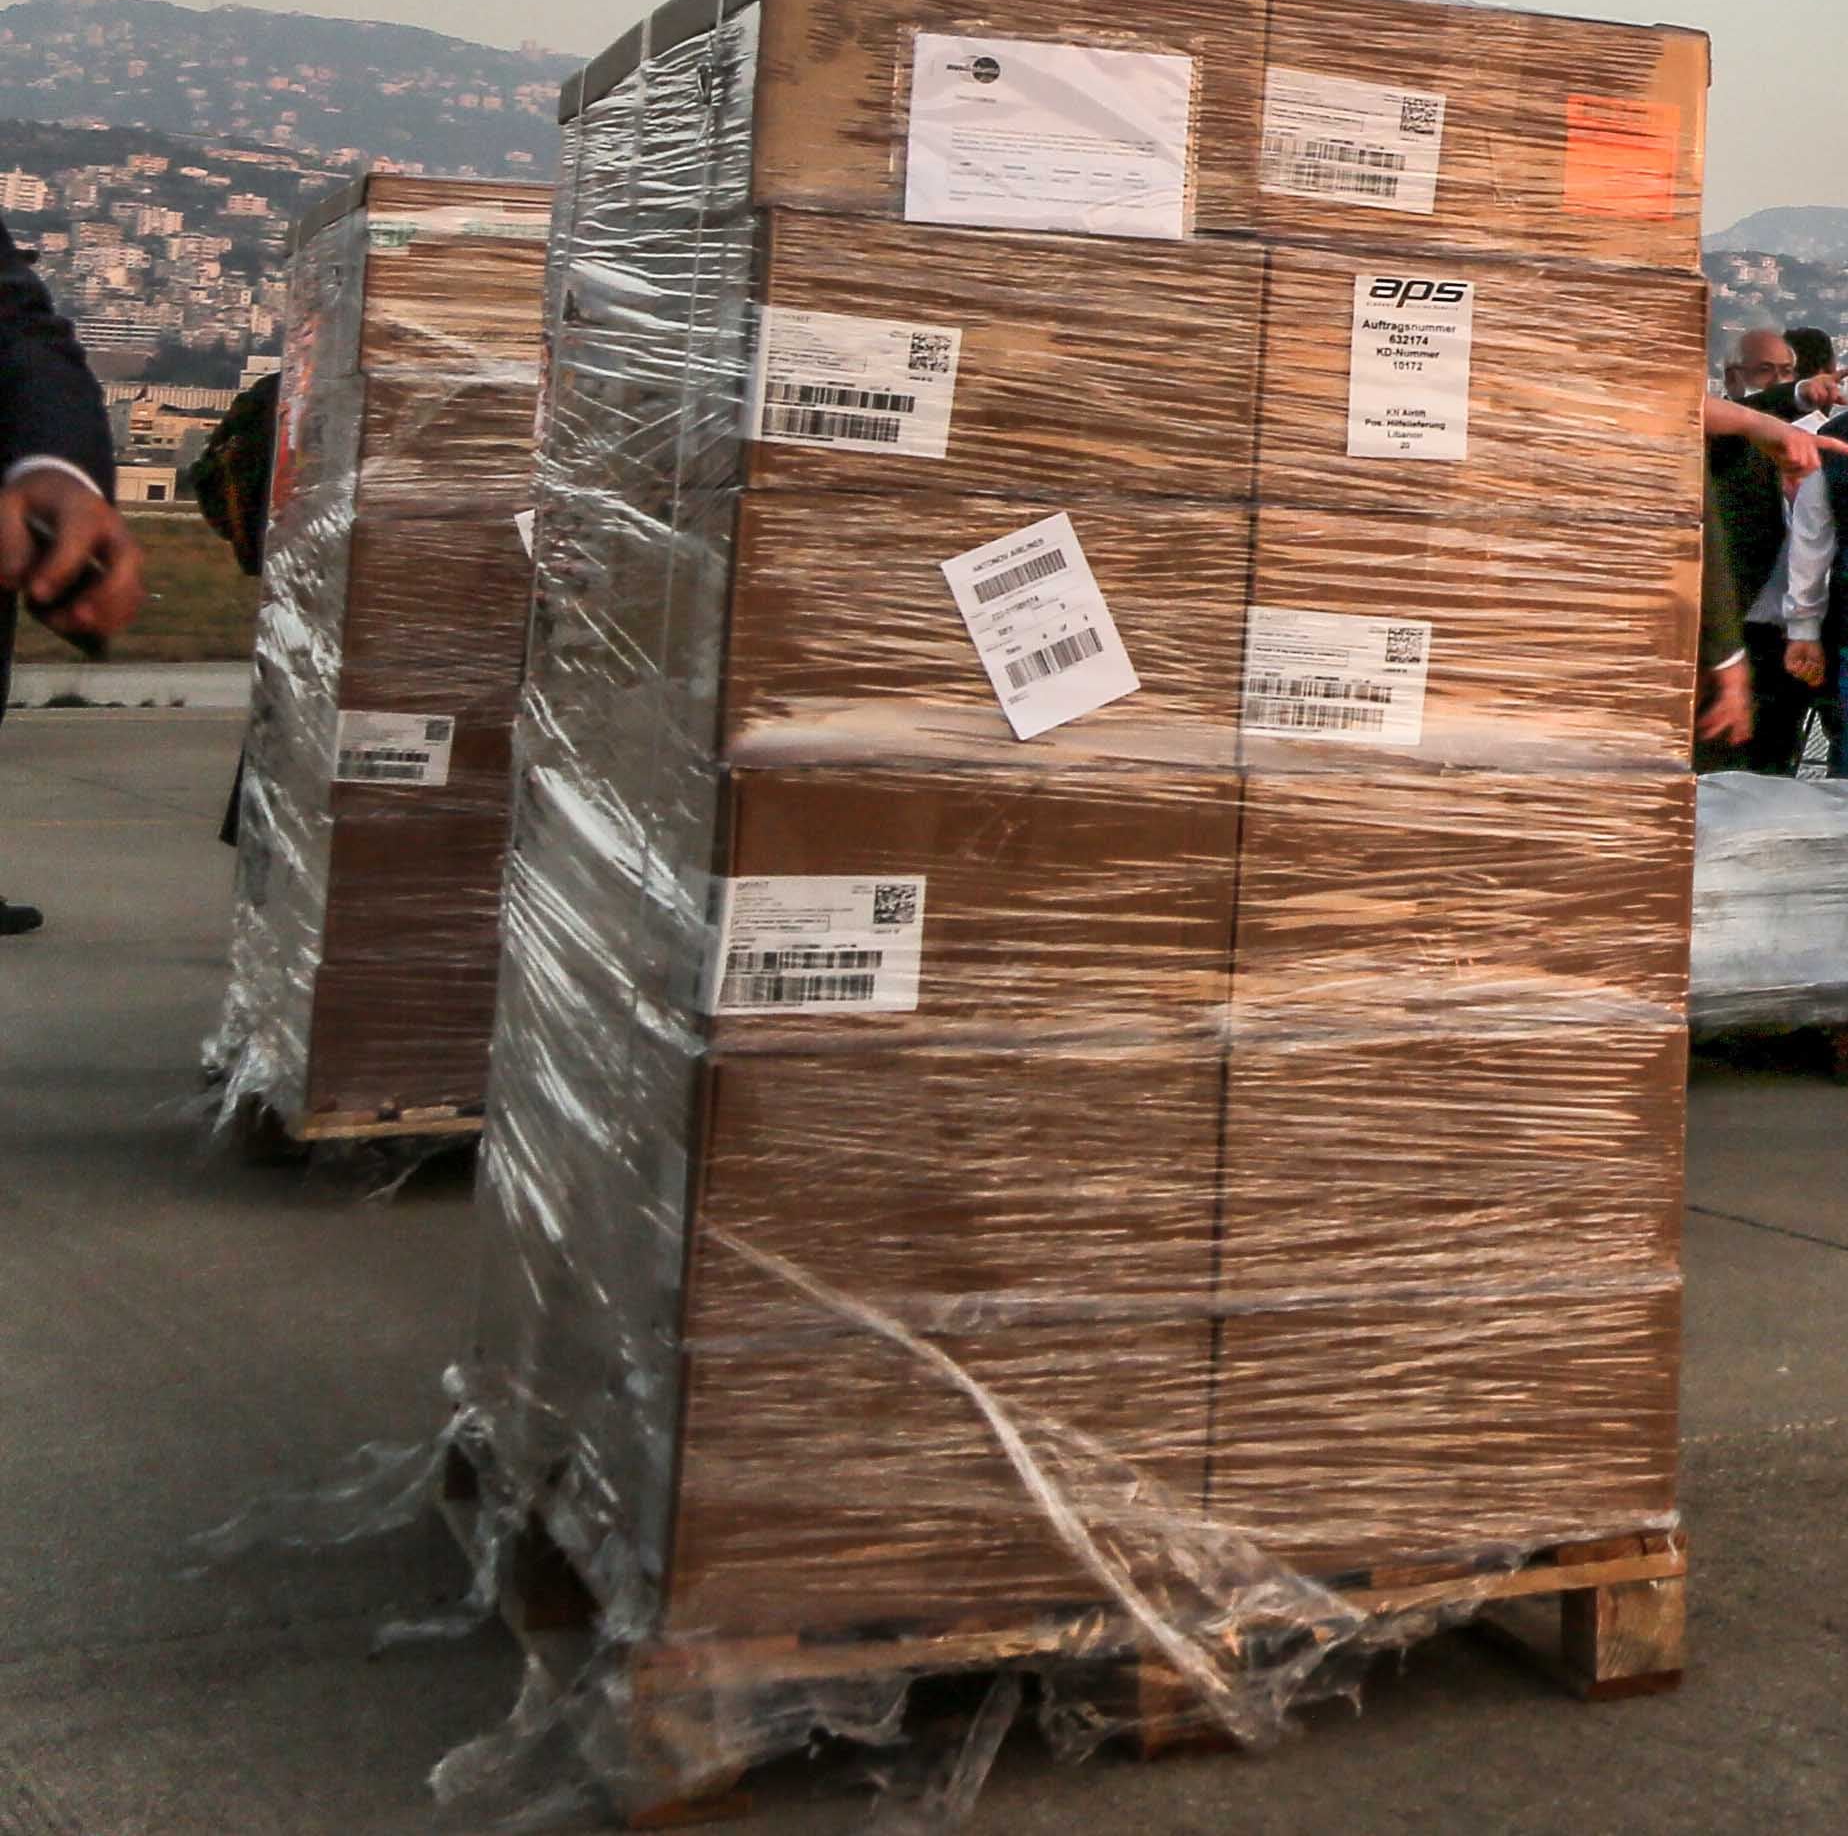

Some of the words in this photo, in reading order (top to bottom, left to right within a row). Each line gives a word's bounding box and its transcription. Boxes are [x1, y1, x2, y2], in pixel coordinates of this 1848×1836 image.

[1369, 278, 1468, 309] aps
[1361, 319, 1456, 333] Auftragsnummer
[1388, 334, 1429, 346] 632174
[1376, 347, 1440, 359] KD-Nummer
